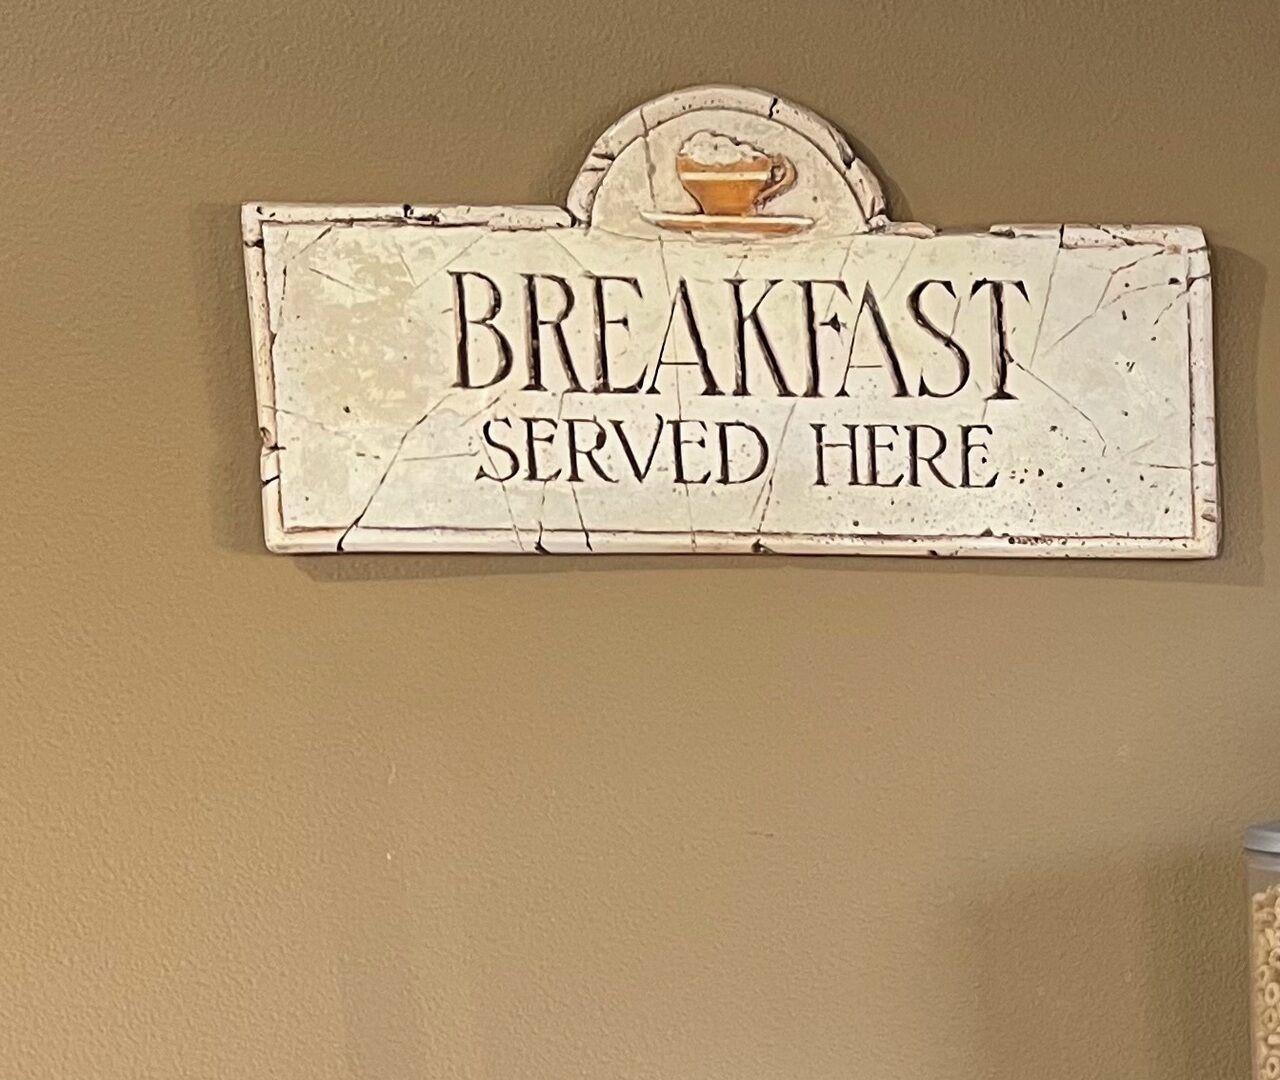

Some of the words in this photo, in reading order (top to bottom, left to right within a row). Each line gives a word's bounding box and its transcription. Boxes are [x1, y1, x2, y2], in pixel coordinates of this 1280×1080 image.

[447, 269, 1029, 401] BREAKFAST
[475, 414, 770, 487] SERVED
[812, 423, 1003, 490] HERE
